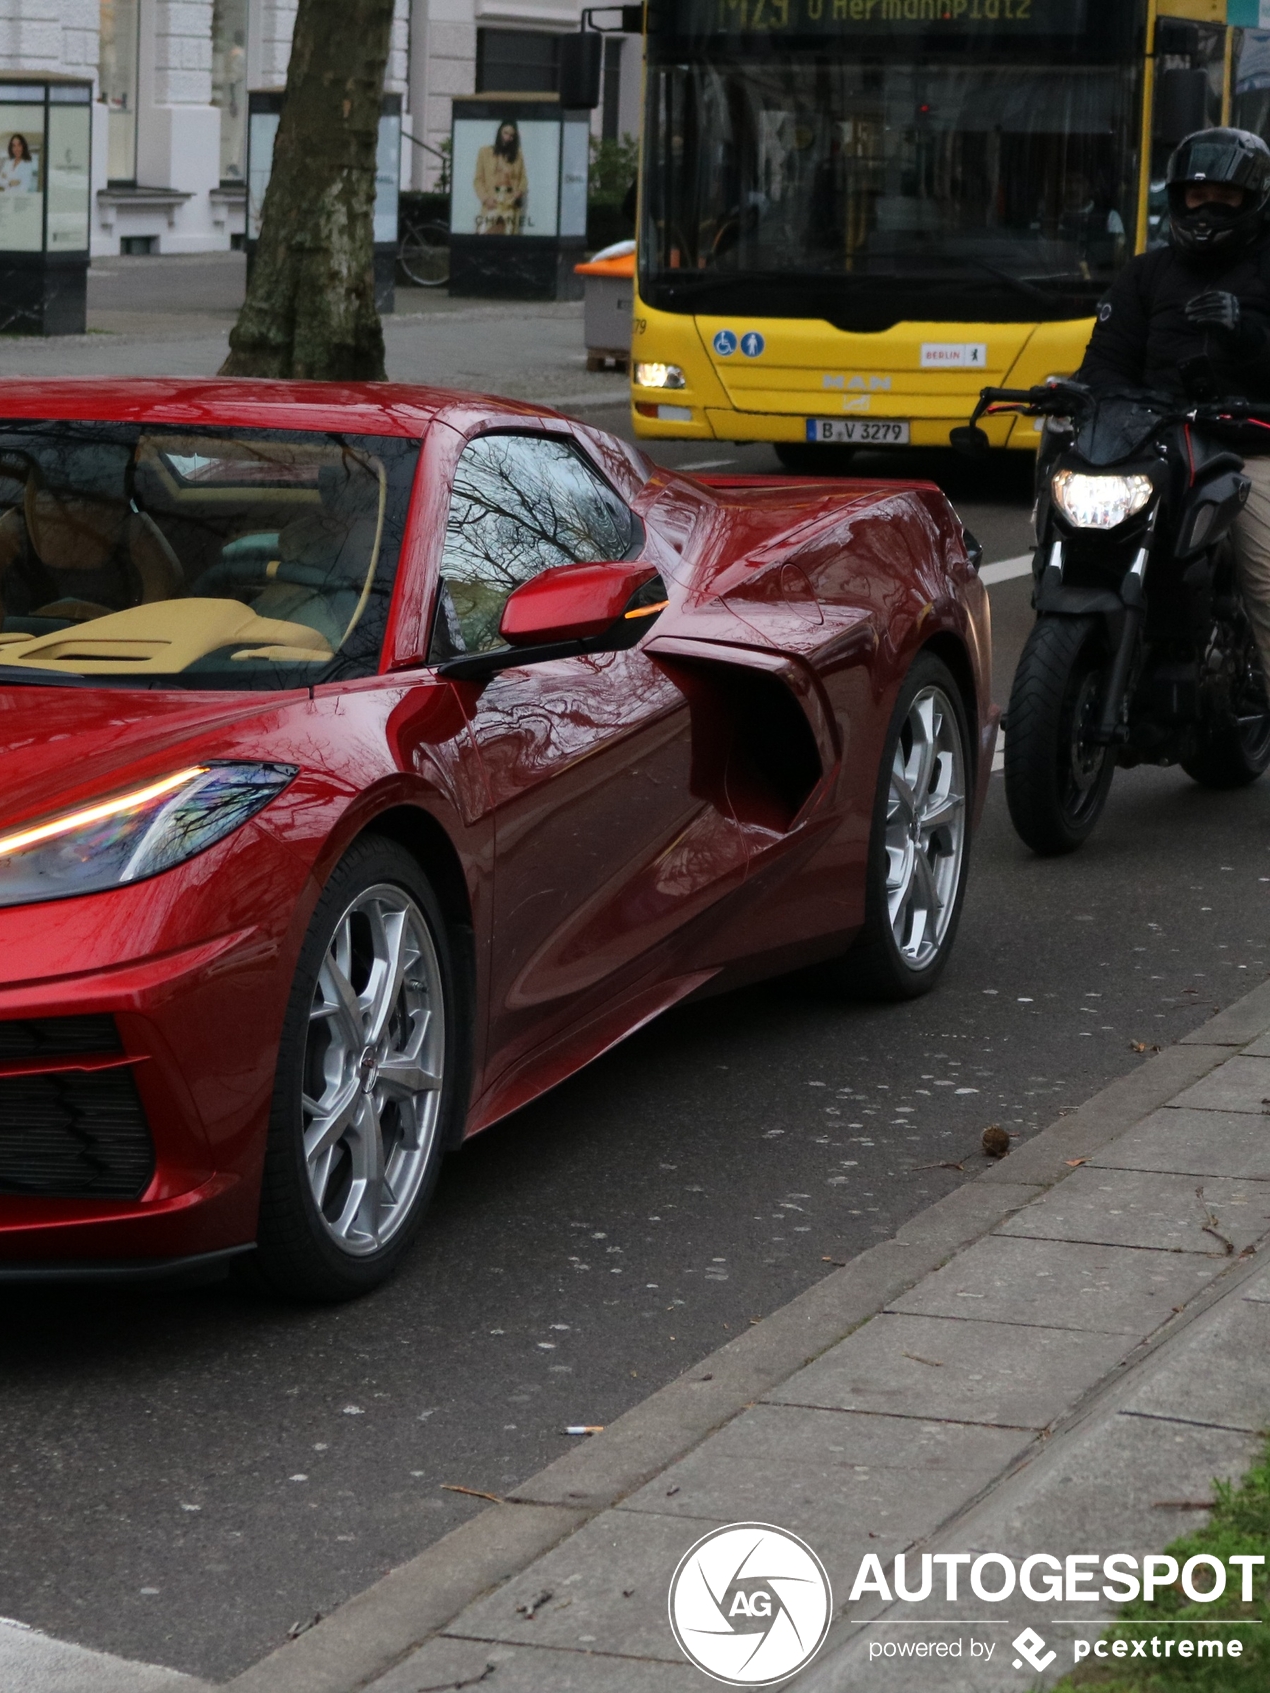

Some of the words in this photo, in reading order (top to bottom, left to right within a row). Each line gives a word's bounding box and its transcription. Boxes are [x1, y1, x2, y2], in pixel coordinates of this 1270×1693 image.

[926, 352, 961, 360] BERLIN
[823, 375, 891, 390] MAN
[822, 423, 834, 439] B
[845, 425, 856, 439] V
[861, 425, 902, 440] 3279
